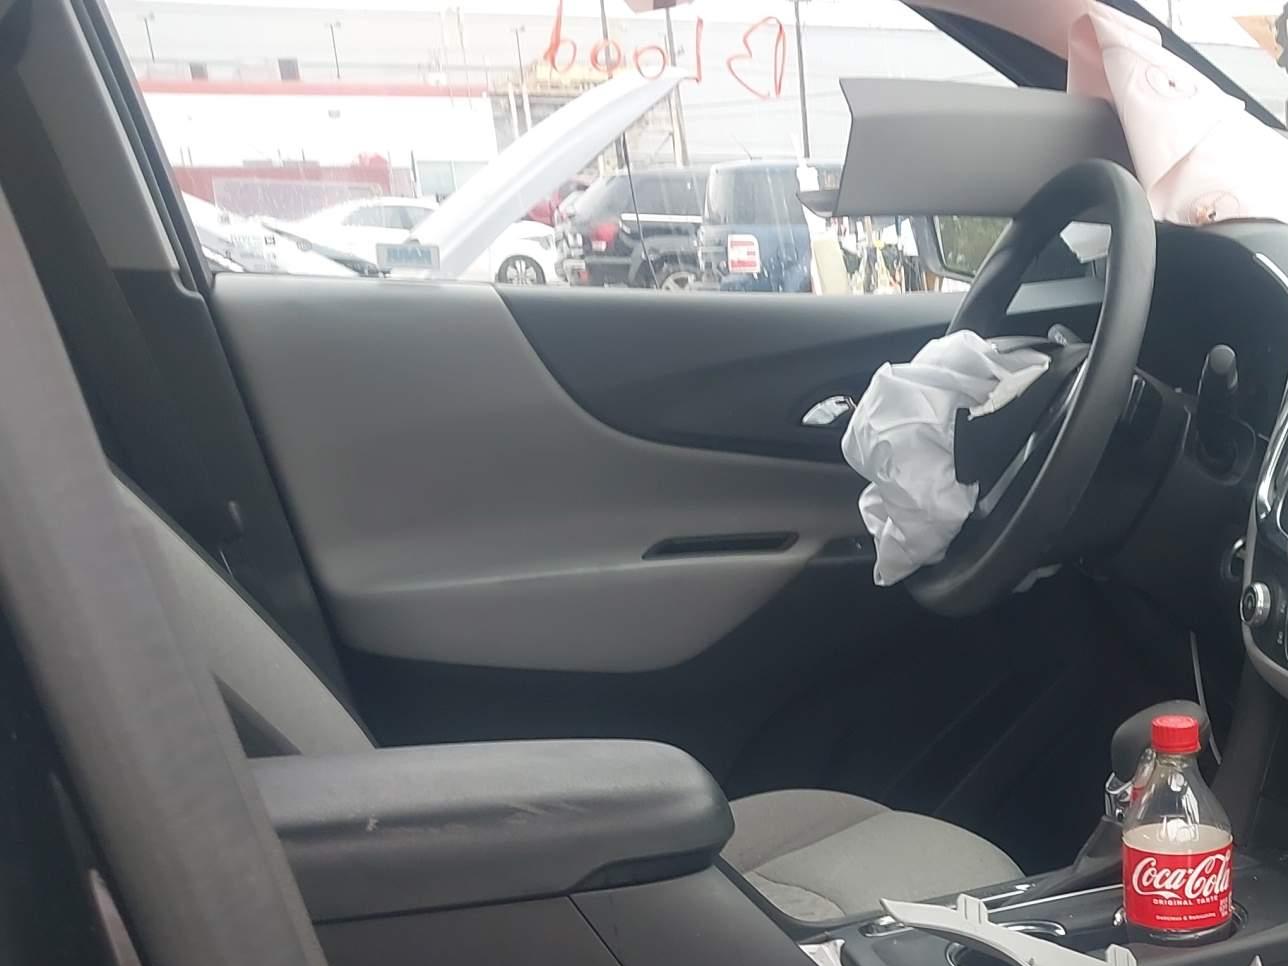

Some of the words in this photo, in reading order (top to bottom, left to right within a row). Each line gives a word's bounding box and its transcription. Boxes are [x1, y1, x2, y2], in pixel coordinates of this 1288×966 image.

[1132, 849, 1231, 899] Coca-Cola
[1152, 898, 1194, 906] ORIGINAL
[1197, 895, 1219, 905] TASTE
